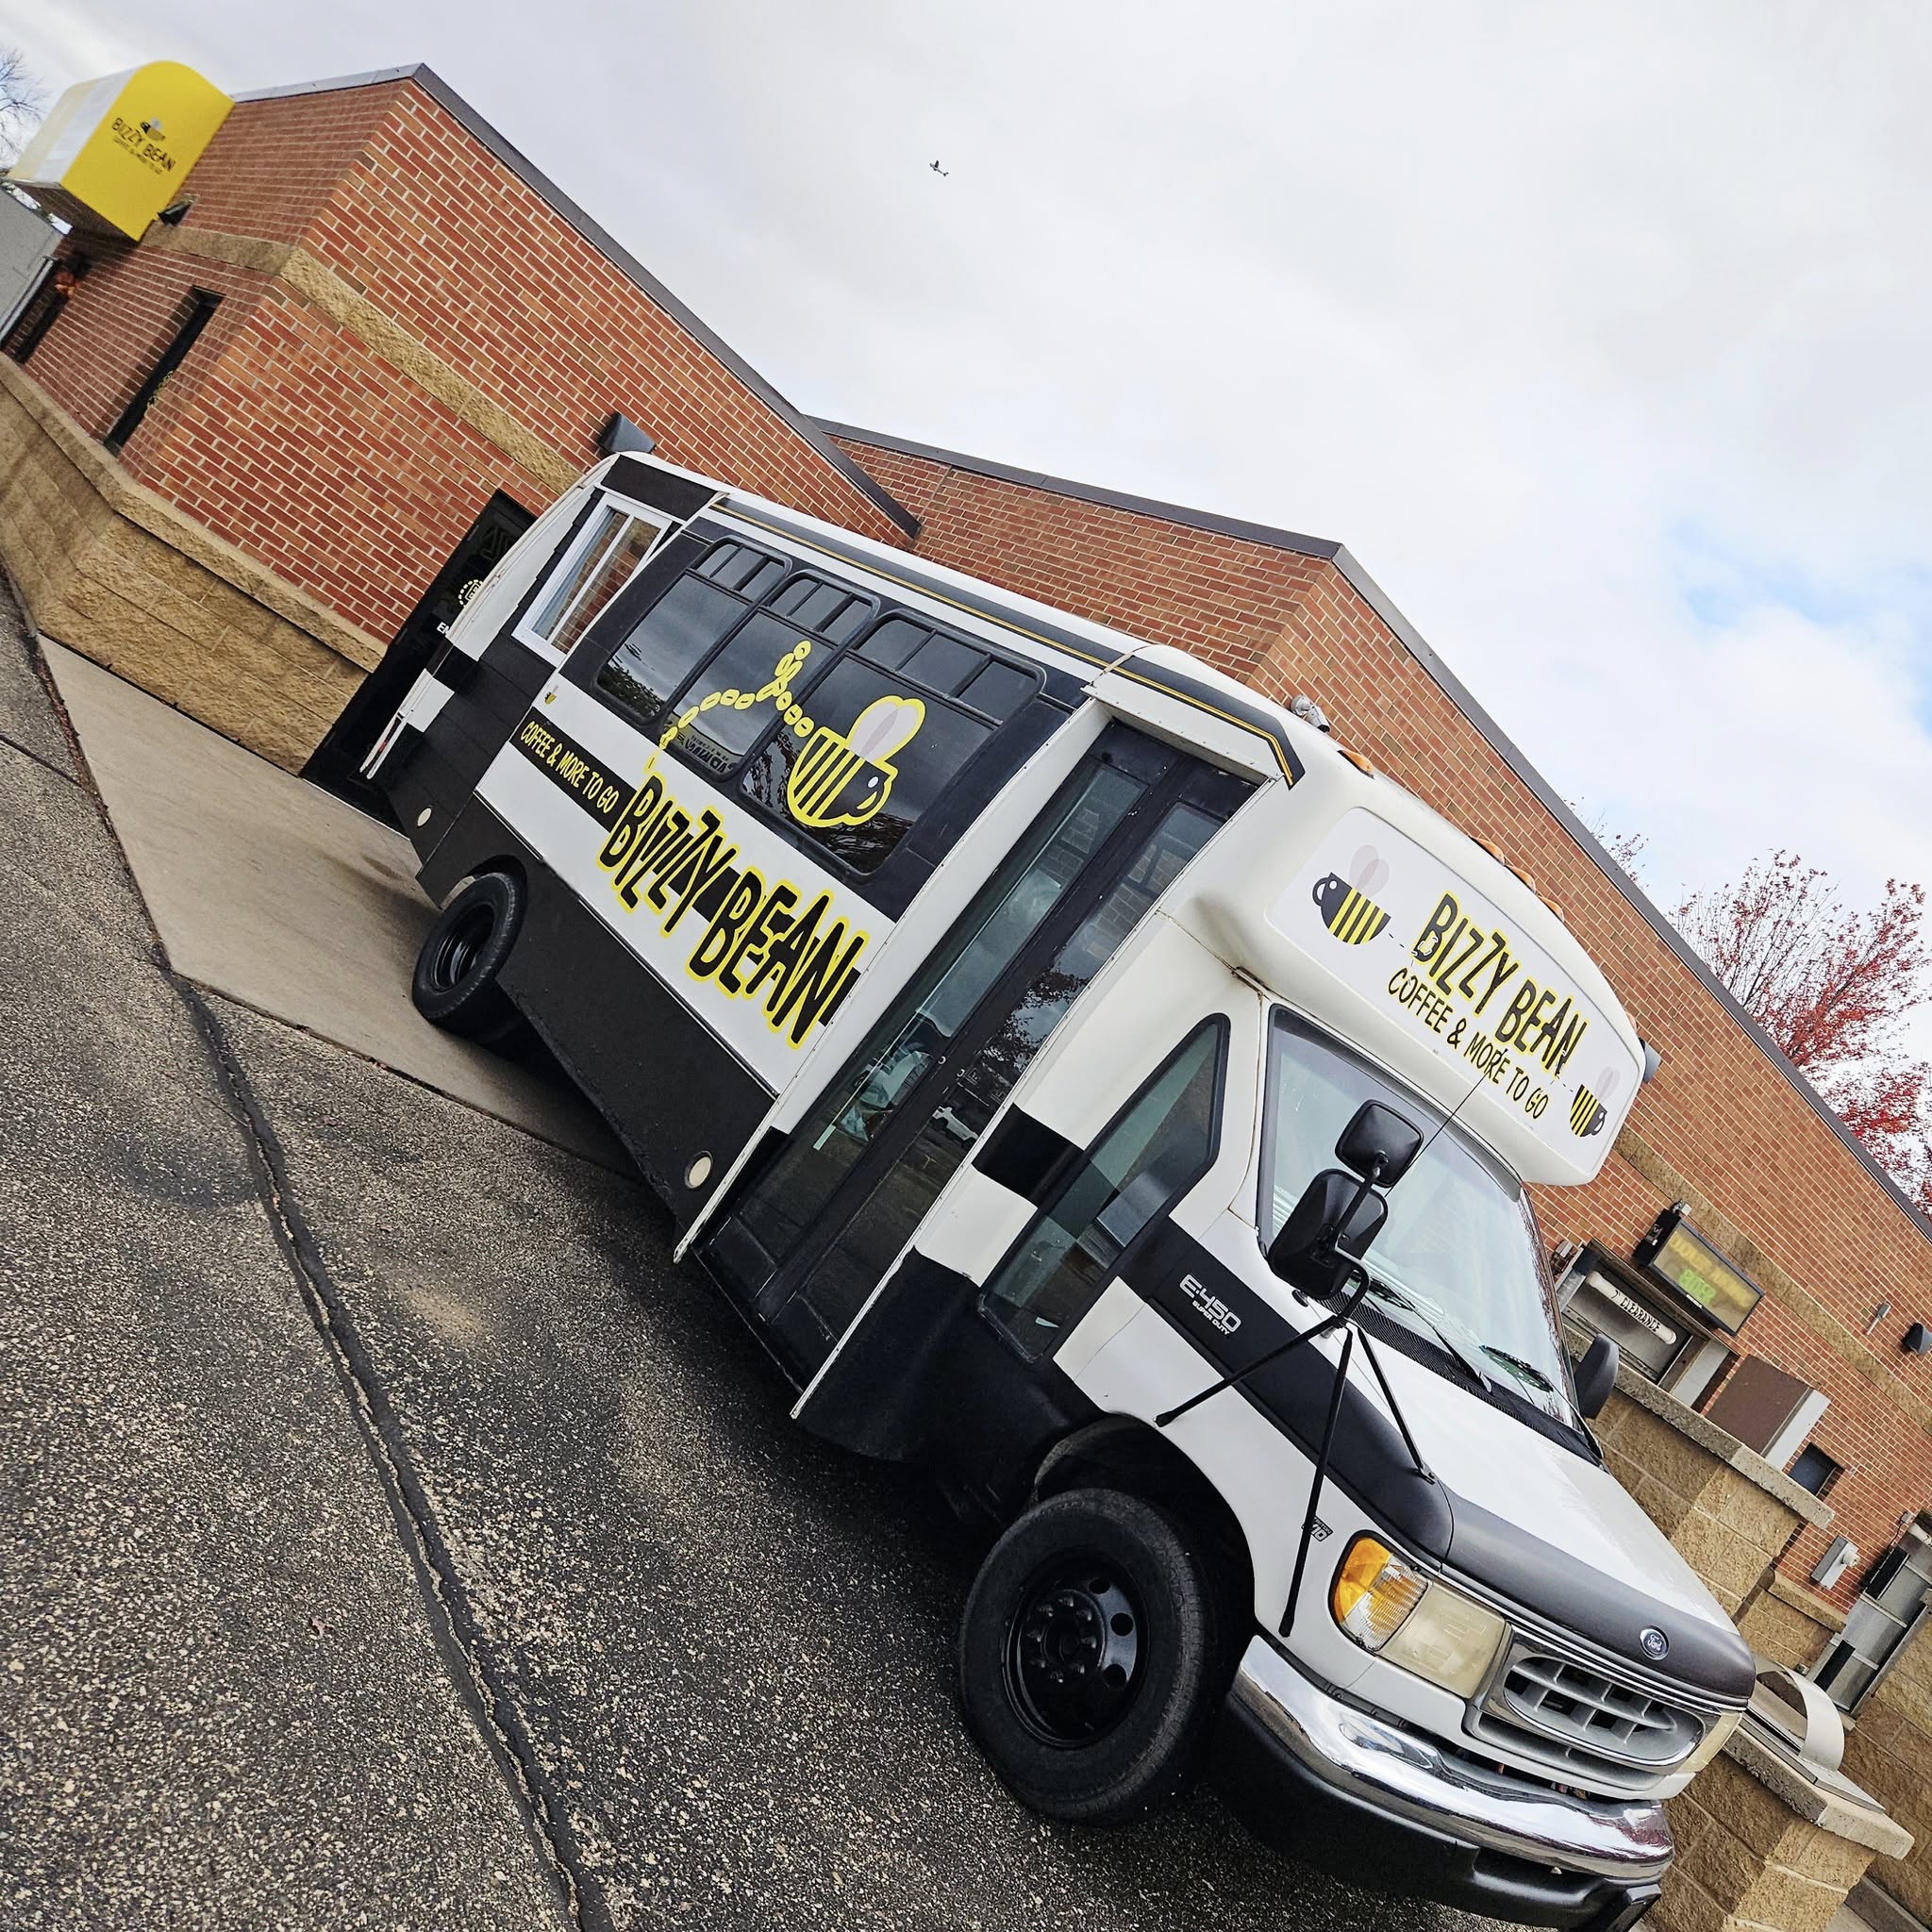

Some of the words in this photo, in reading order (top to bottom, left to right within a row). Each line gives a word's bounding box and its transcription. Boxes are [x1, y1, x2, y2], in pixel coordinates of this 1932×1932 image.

[111, 117, 143, 146] BIZZY
[143, 143, 175, 173] BEAN
[520, 721, 555, 758] COFFEE
[546, 742, 563, 767] &
[555, 750, 591, 788] MORE
[582, 771, 604, 800] TO
[596, 785, 620, 814] GO
[599, 777, 738, 936] BIZZY
[688, 869, 868, 1047] BEAN
[1411, 891, 1520, 1016] BIZZY
[1494, 978, 1589, 1076] BEAN
[1388, 967, 1454, 1034] COFFEE
[1446, 1018, 1468, 1050] &
[1463, 1031, 1511, 1085] MORE
[1506, 1066, 1530, 1102] TO
[1524, 1087, 1549, 1120] GO
[1179, 1274, 1241, 1332] E-450
[1191, 1300, 1214, 1321] SUPER
[1211, 1318, 1230, 1335] DUTY
[1620, 1297, 1660, 1333] CLEARANCE
[1647, 1634, 1662, 1651] Ford
